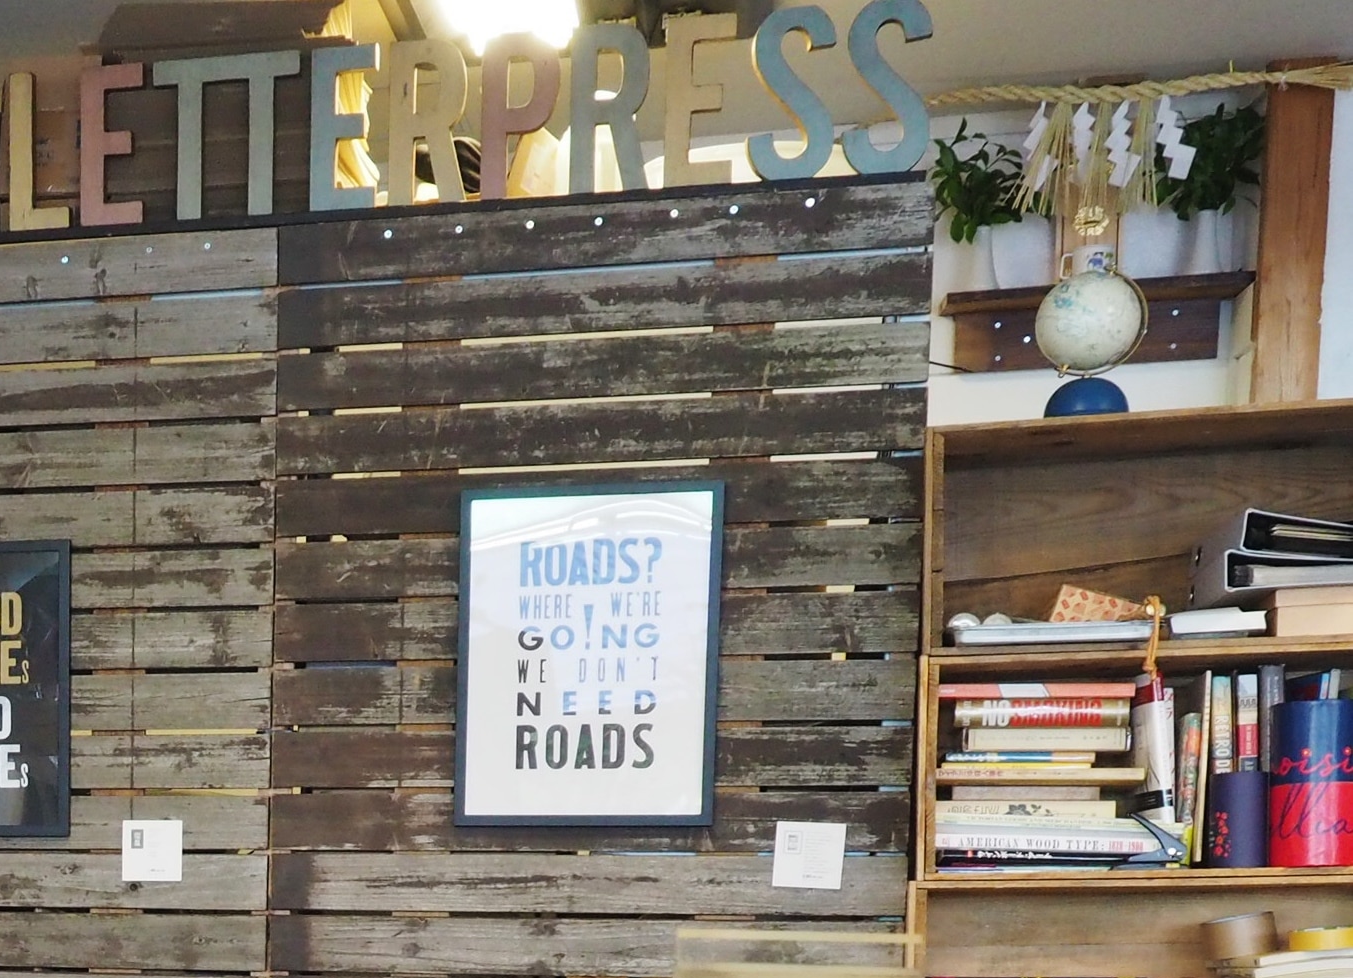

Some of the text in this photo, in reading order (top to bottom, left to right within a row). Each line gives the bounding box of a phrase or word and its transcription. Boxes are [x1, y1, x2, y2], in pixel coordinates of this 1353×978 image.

[8, 0, 934, 232] LETTERPRESS
[519, 536, 663, 588] ROADS?
[519, 591, 662, 620] WHERE WE'RE
[517, 656, 659, 683] WE DON'T
[516, 690, 657, 717] NEED
[982, 699, 1011, 727] NO
[515, 723, 655, 770] ROADS
[957, 836, 1020, 850] AMERICAN
[1025, 838, 1061, 851] WOOD
